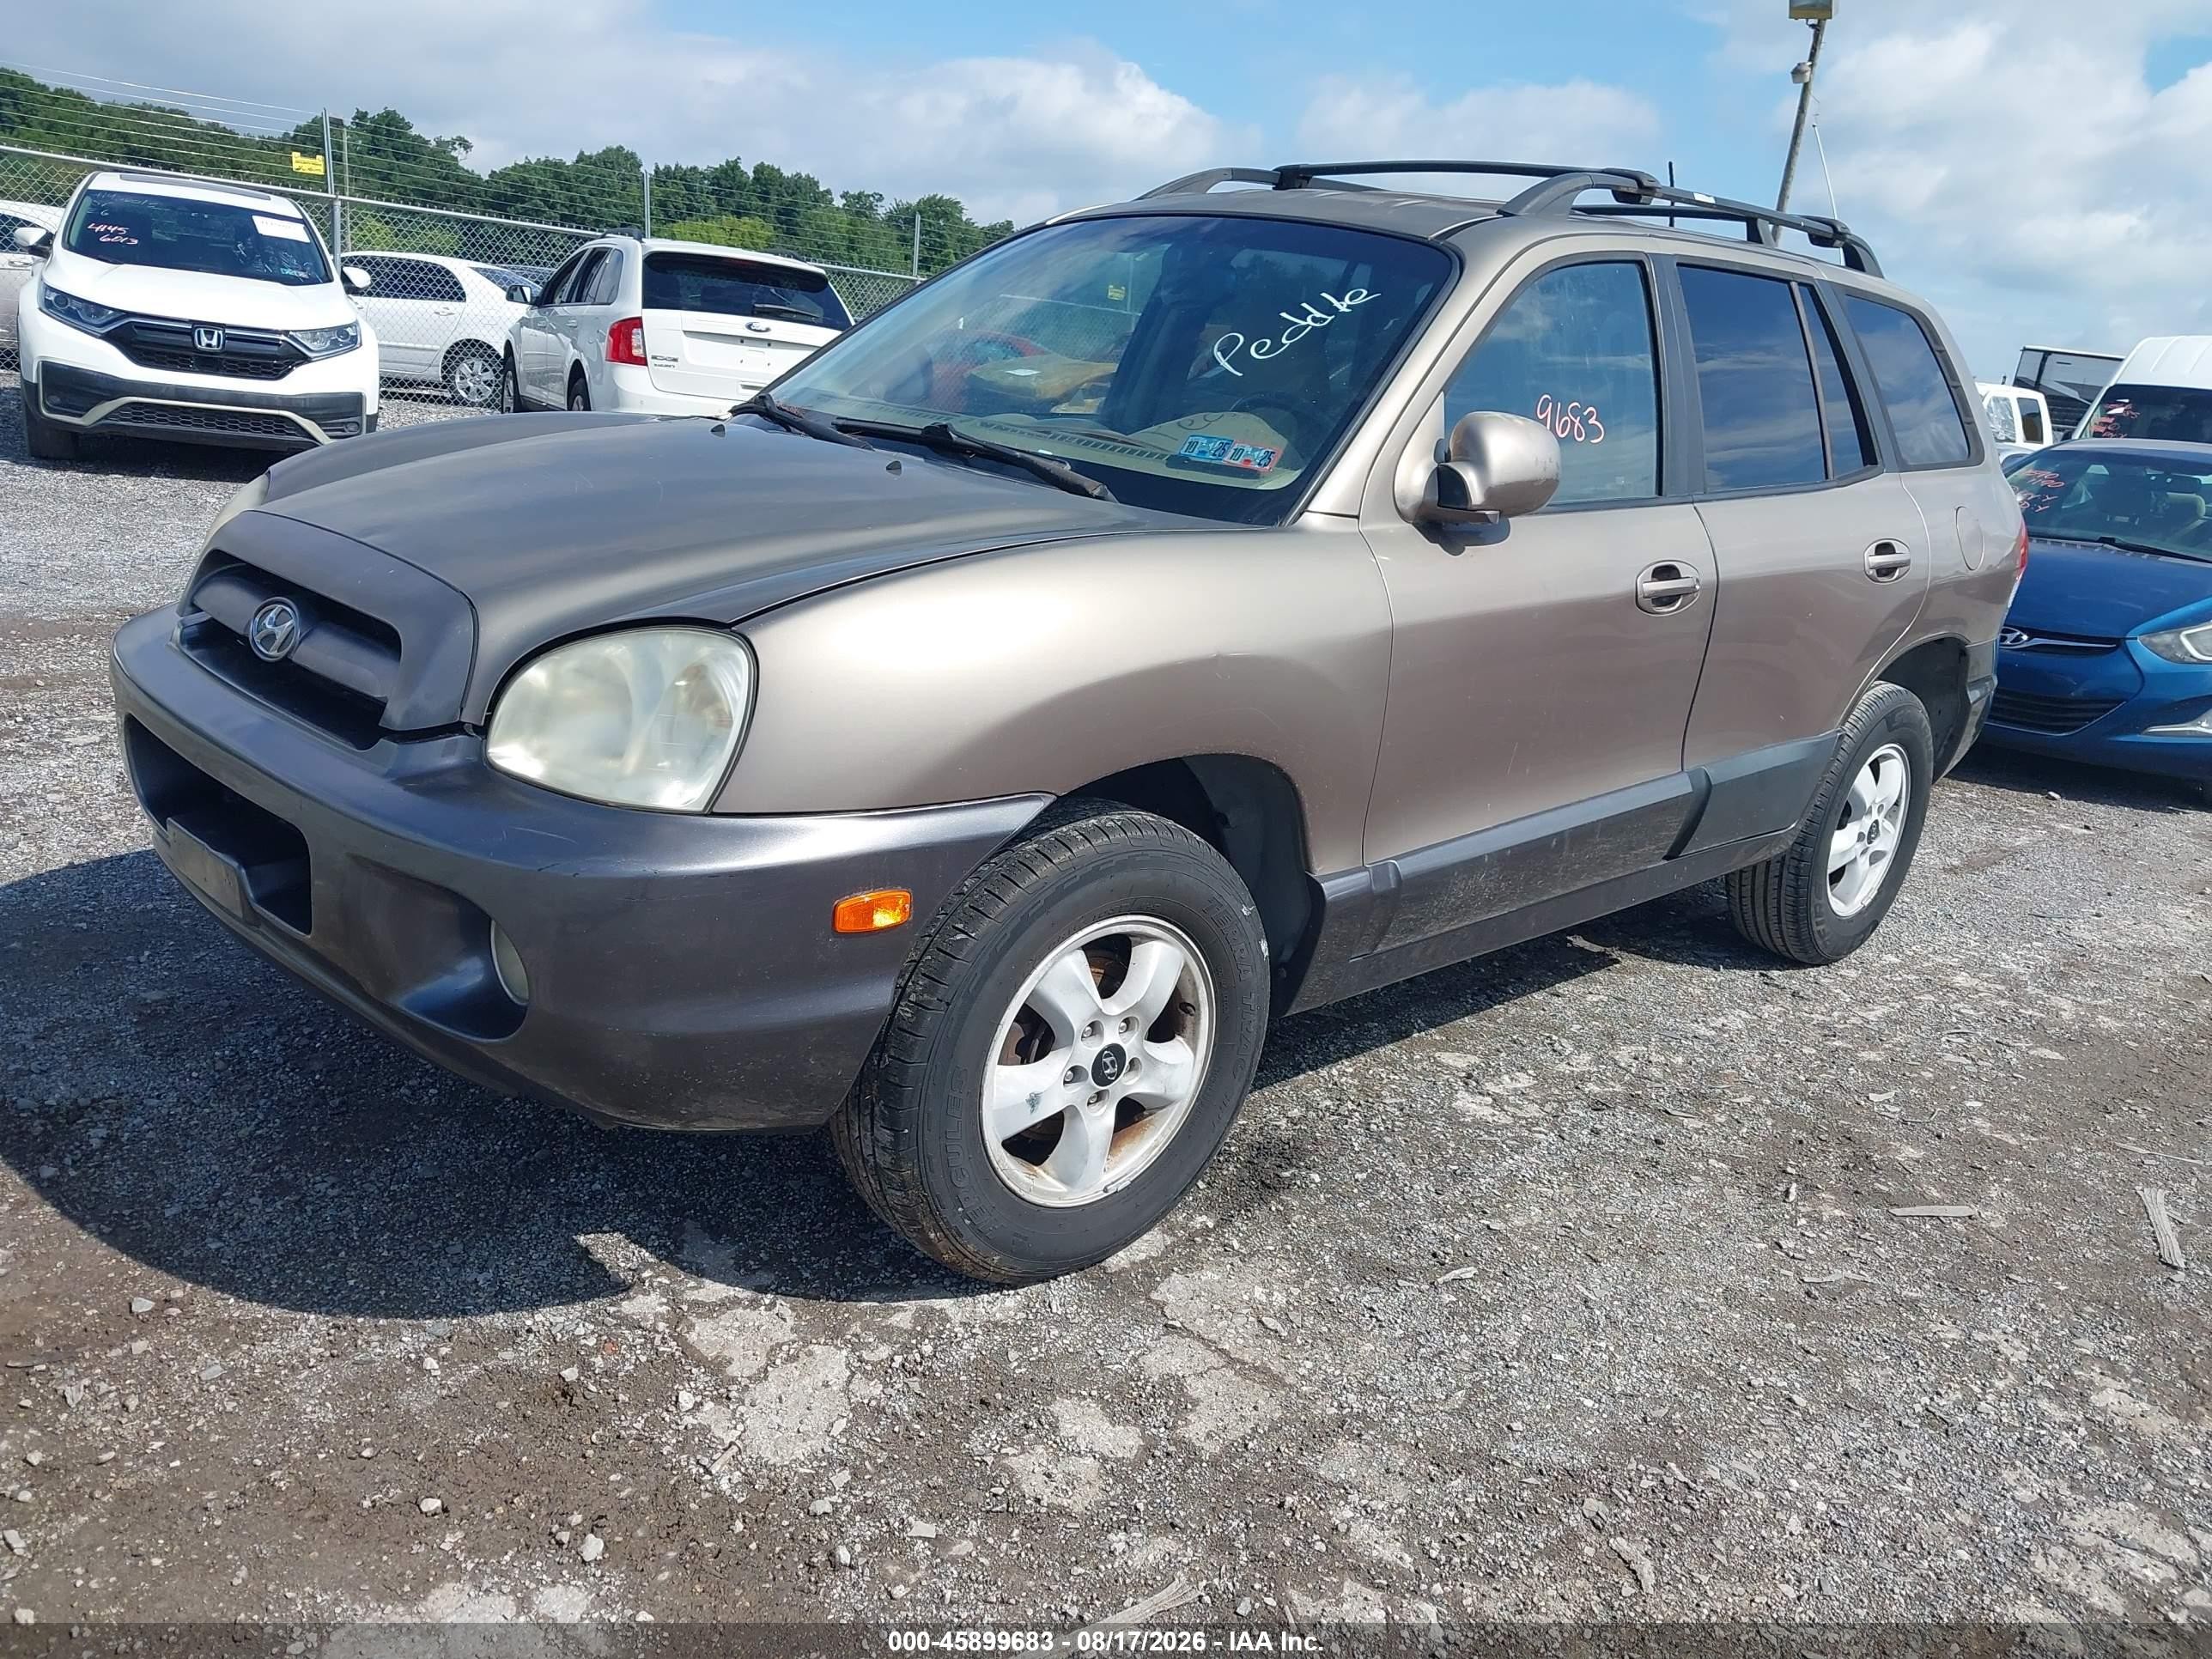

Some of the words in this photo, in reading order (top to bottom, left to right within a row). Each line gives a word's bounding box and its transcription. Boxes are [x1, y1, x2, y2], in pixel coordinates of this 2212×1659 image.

[99, 234, 139, 245] 6013
[1536, 394, 1605, 443] 9683
[1185, 440, 1199, 454] 10
[1230, 448, 1244, 460] 10
[1258, 451, 1275, 466] 25
